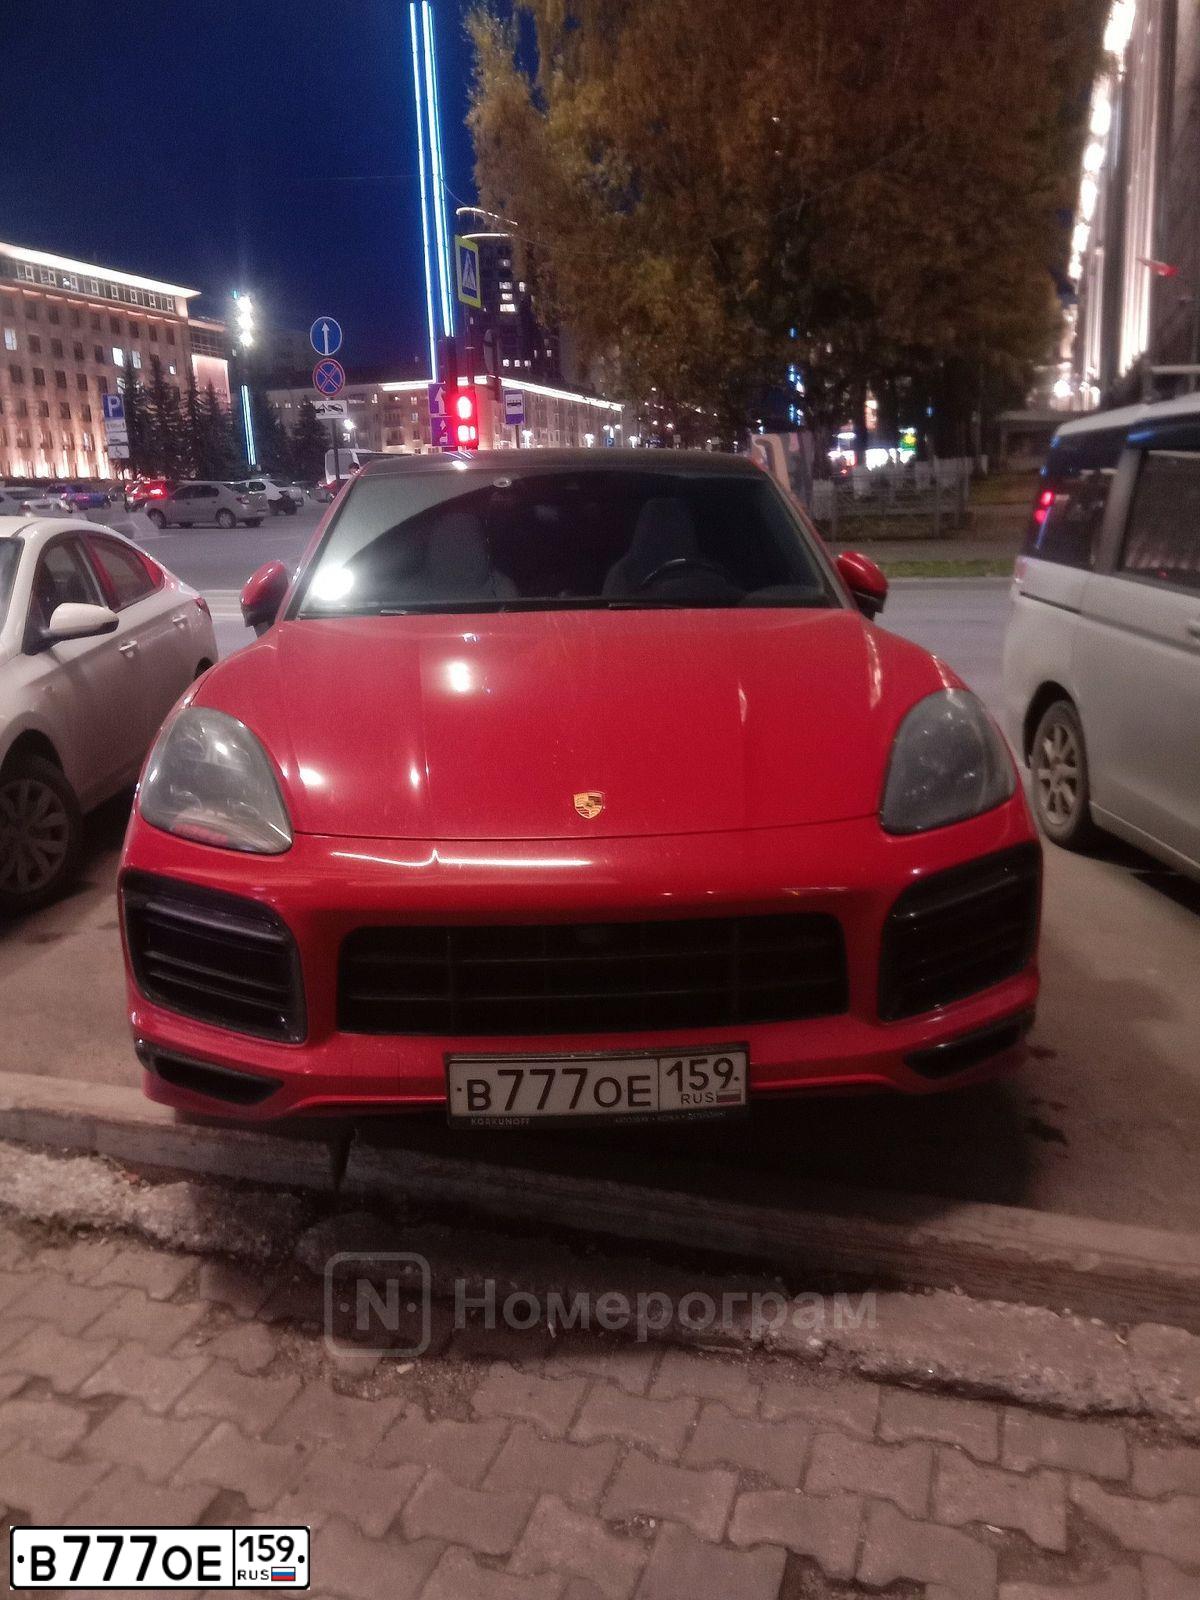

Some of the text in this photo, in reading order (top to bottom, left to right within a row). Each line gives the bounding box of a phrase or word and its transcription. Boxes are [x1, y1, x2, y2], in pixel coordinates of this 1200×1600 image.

[107, 396, 121, 417] P
[467, 1057, 734, 1111] В777ОЕ 159
[681, 1091, 715, 1105] RUS
